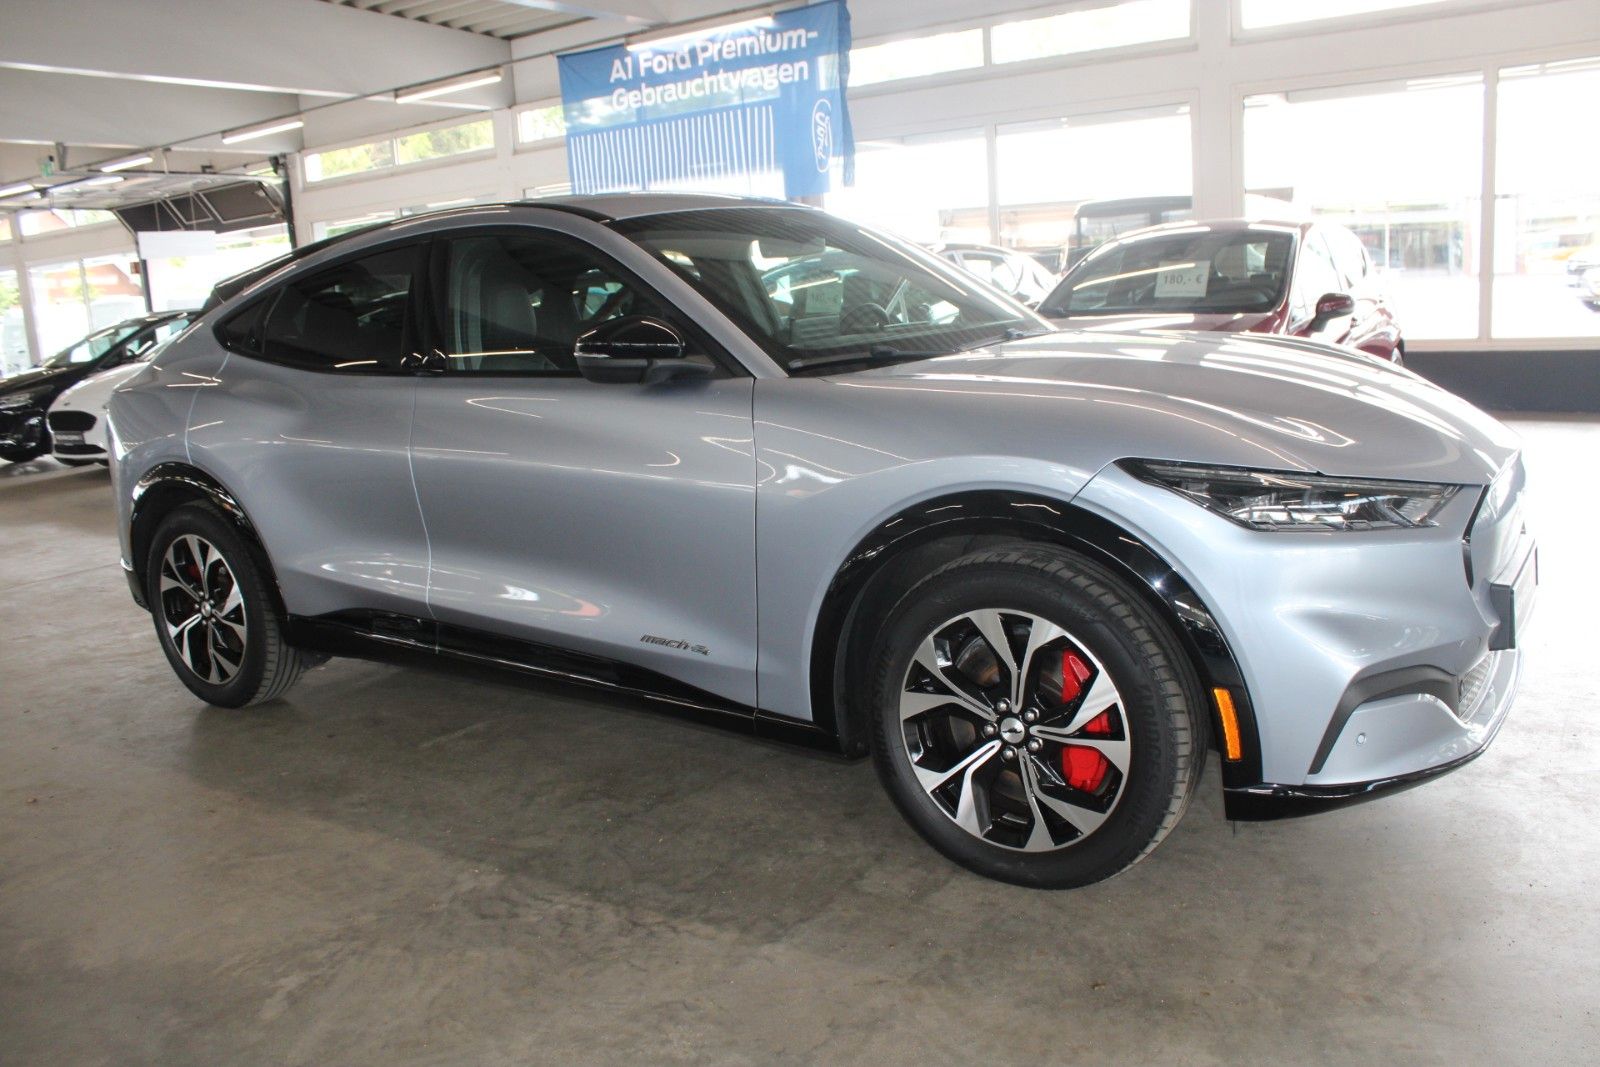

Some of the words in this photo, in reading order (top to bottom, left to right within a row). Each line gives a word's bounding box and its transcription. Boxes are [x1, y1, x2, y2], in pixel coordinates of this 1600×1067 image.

[609, 58, 634, 84] A1
[639, 47, 692, 74] Ford
[698, 28, 818, 66] Premium-
[612, 60, 808, 112] Gebrauchtwagen
[814, 110, 830, 160] Ford
